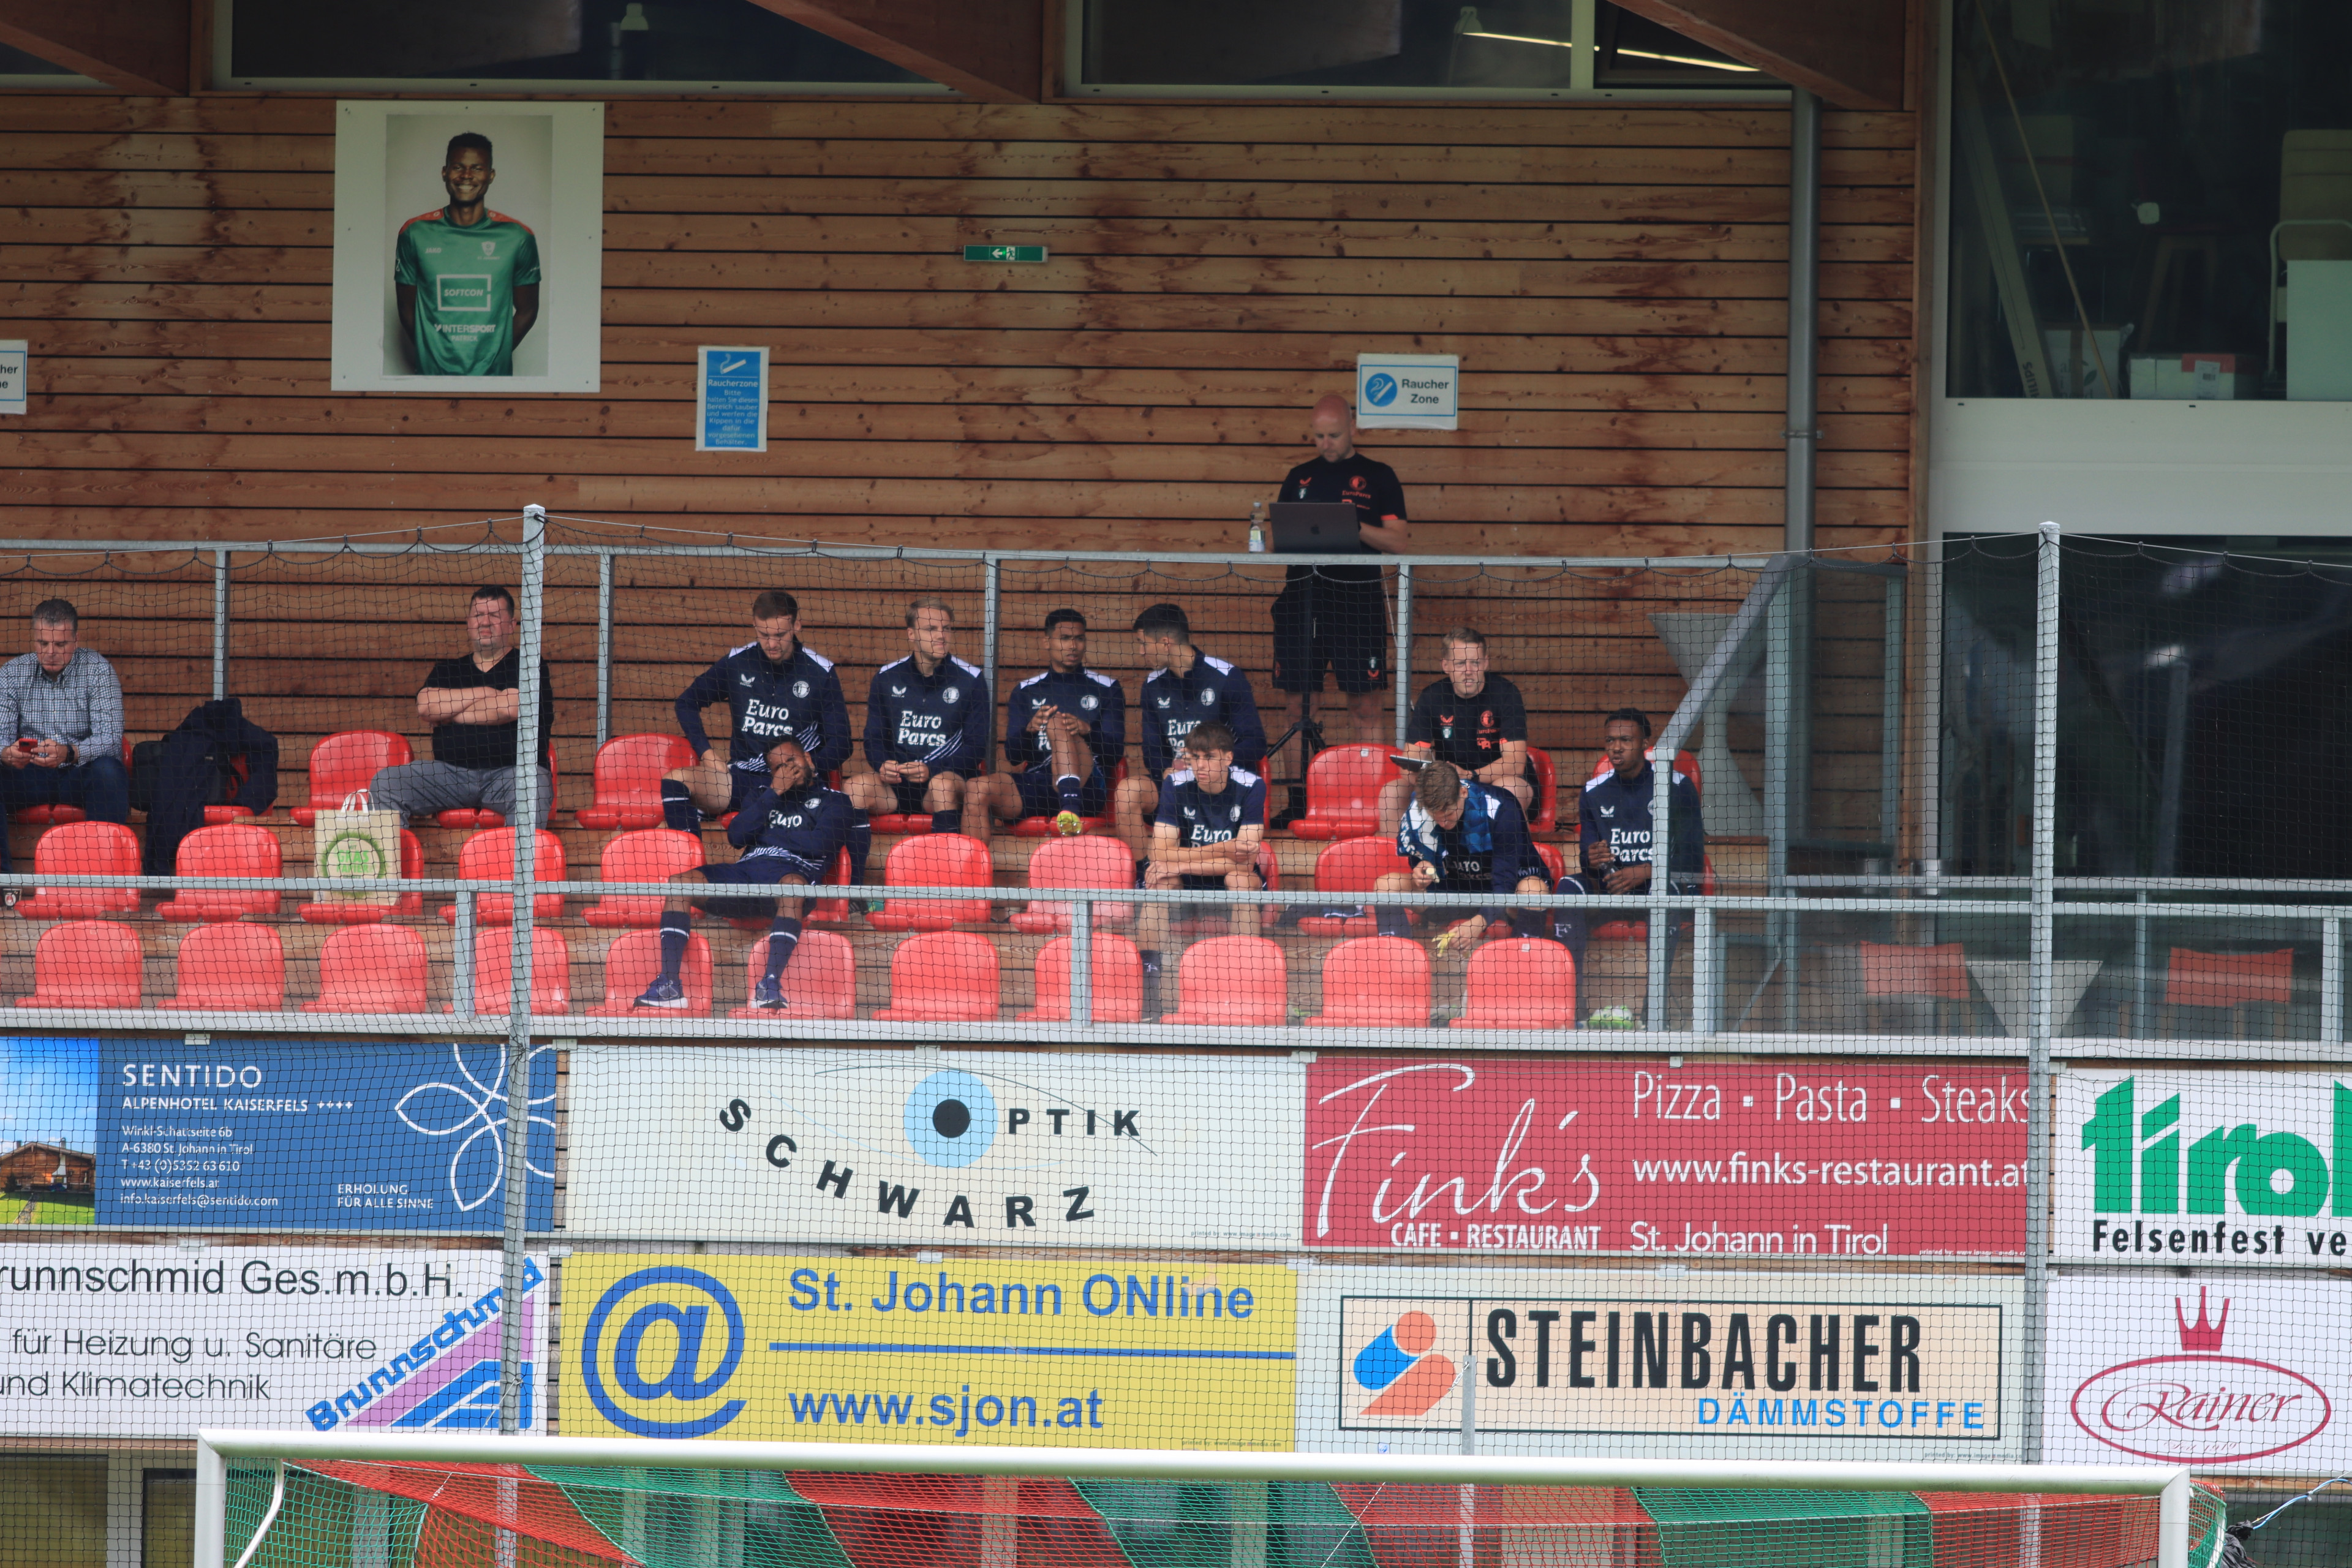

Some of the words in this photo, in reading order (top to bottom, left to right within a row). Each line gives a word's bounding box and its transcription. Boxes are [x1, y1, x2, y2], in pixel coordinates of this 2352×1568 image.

[442, 324, 496, 333] INTERSPORT
[1401, 379, 1449, 389] Raucher
[1411, 394, 1439, 404] Zone
[1341, 490, 1371, 499] EuroParcs
[746, 699, 789, 720] Euro
[741, 716, 793, 737] Parcs
[900, 710, 941, 729] Euro
[1167, 719, 1201, 735] Eur
[897, 728, 946, 746] Parcs
[769, 810, 802, 828] Euro
[1191, 824, 1232, 844] Euro
[1610, 828, 1651, 845] Euro
[338, 850, 369, 862] GRAS
[336, 864, 369, 873] PAPIER
[1453, 861, 1480, 872] uro
[123, 1064, 262, 1088] SENTIDO
[122, 1097, 217, 1110] ALPENHOTEL
[224, 1098, 307, 1112] KAISERFELS
[1634, 1071, 1721, 1120] Pizza
[1776, 1073, 1867, 1122] Pasta
[1921, 1074, 2029, 1123] Steaks
[122, 1126, 216, 1137] Winkl-Schattseite
[219, 1127, 232, 1137] 6b
[122, 1143, 161, 1153] A-6380
[163, 1143, 176, 1153] St.
[178, 1144, 214, 1156] Johann
[217, 1144, 227, 1153] in
[228, 1144, 253, 1154] Tirol
[1312, 1063, 1599, 1238] Fink's
[121, 1159, 128, 1169] T
[131, 1159, 151, 1170] +43
[203, 1160, 216, 1170] 63
[218, 1161, 240, 1171] 610
[719, 1098, 1095, 1229] SCHWARZ
[1633, 1152, 2027, 1187] www.finks-restaurant.at
[121, 1177, 219, 1188] www.kaiserfels.at
[337, 1183, 408, 1195] ERHOLUNG
[120, 1193, 278, 1208] info.kaiserfels@sentido.com
[337, 1195, 361, 1208] FÜR
[364, 1197, 394, 1208] ALLE
[397, 1197, 434, 1209] SINNE
[1391, 1223, 1441, 1247] CAFE
[1467, 1224, 1601, 1250] RESTAURANT
[1630, 1221, 1666, 1252] St.
[1675, 1221, 1783, 1253] Johann
[1793, 1224, 1816, 1253] in
[1824, 1224, 1887, 1254] Tirol
[2093, 1219, 2284, 1254] Felsenfest
[2307, 1231, 2346, 1255] ve
[241, 1260, 463, 1297] Ges.m.b.H.
[788, 1268, 853, 1312] St.
[872, 1270, 1062, 1315] Johann
[1082, 1273, 1254, 1318] ONline
[12, 1328, 51, 1354] für
[64, 1330, 192, 1363] Heizung
[205, 1338, 230, 1357] u.
[245, 1332, 377, 1359] Sanitäre
[305, 1256, 545, 1431] Brunnschmd
[581, 1266, 747, 1439] @
[1487, 1308, 1921, 1392] STEINBACHER
[62, 1371, 270, 1399] Klimatechnik
[788, 1385, 1103, 1438] www.sjon.at
[1698, 1392, 1984, 1429] DÄMMSTOFFE
[2102, 1382, 2302, 1431] Rainer
[2163, 1441, 2196, 1451] Seit
[2204, 1442, 2237, 1452] 1919
